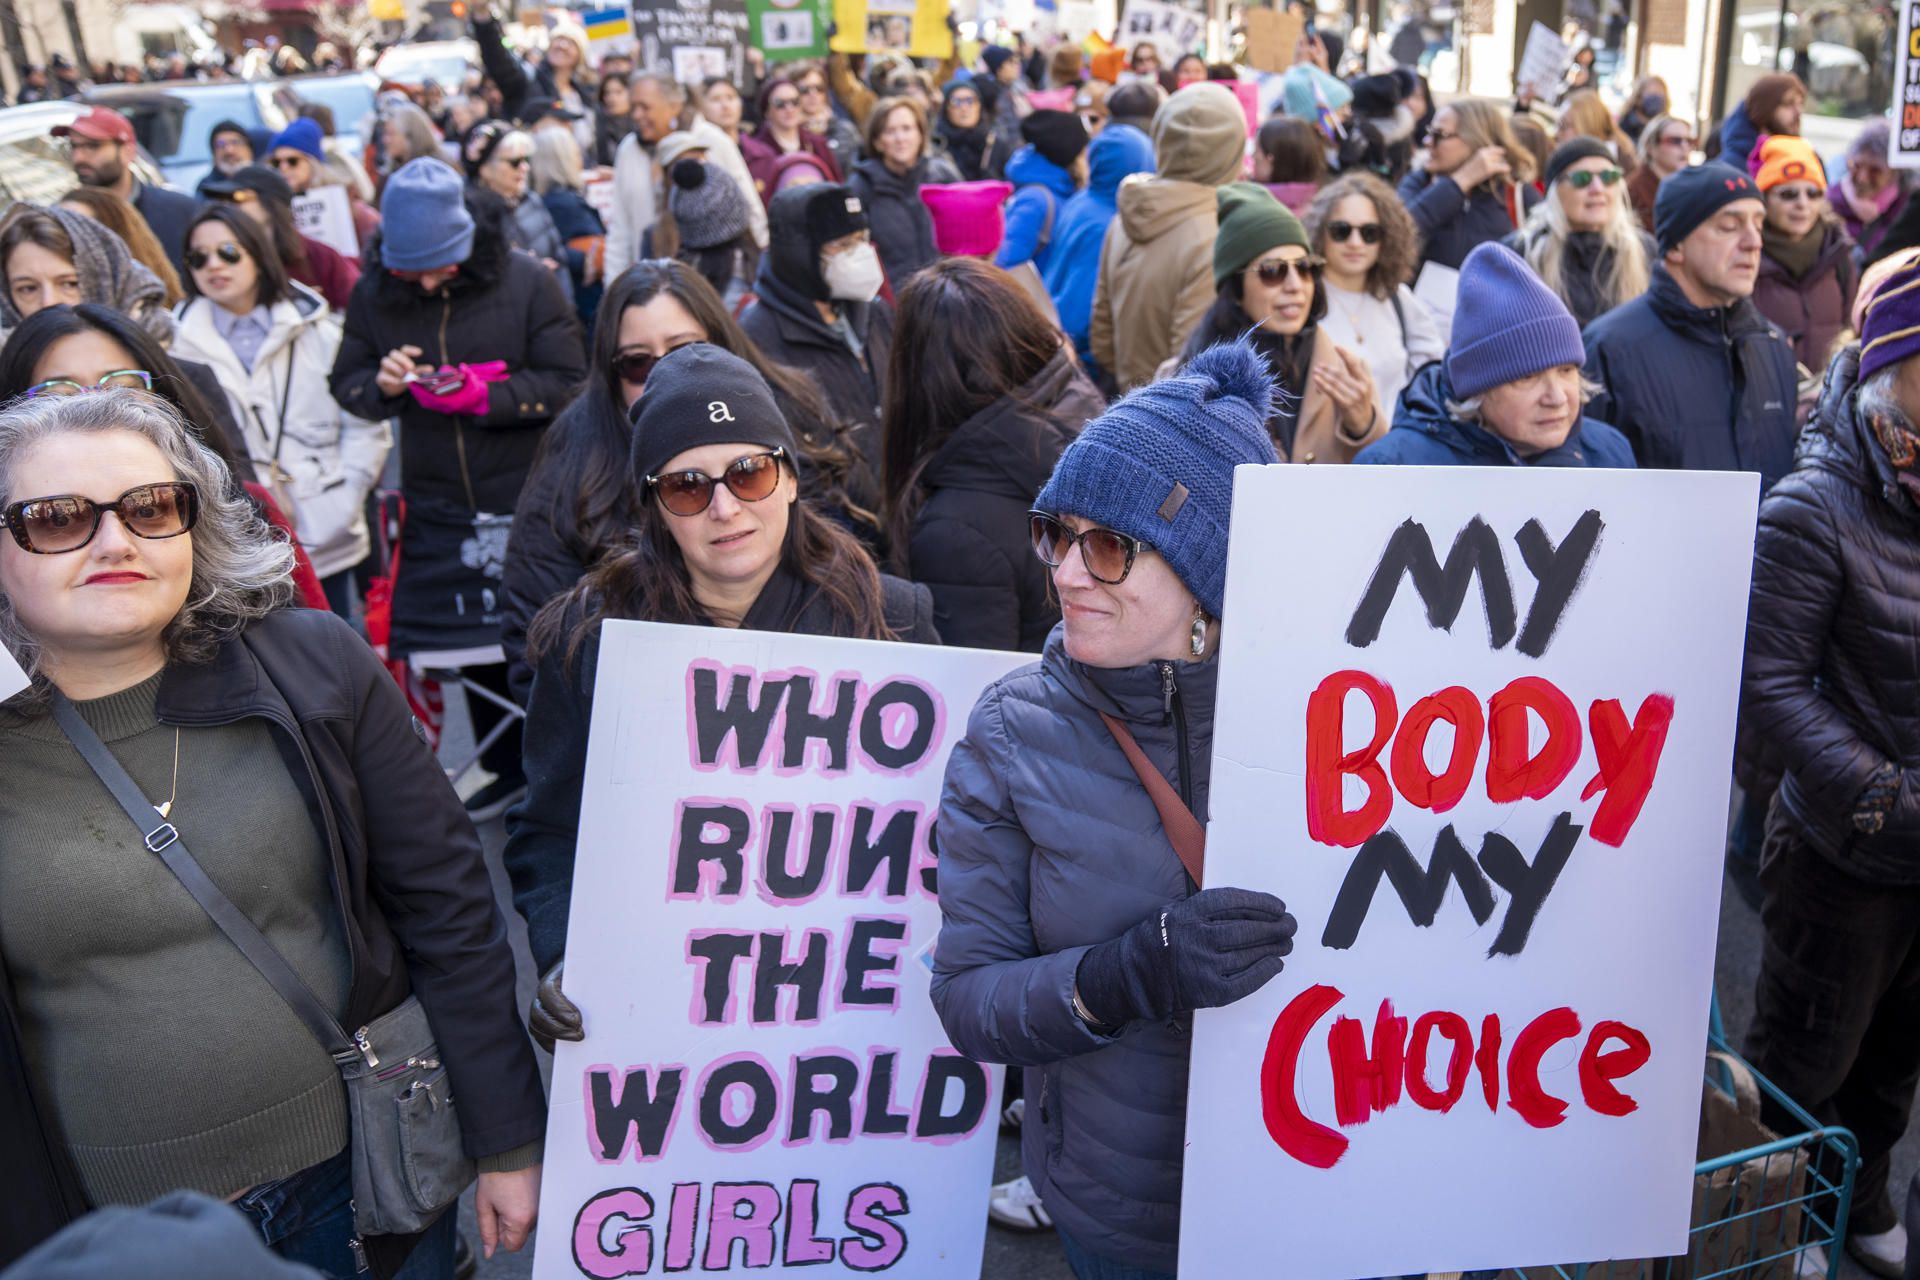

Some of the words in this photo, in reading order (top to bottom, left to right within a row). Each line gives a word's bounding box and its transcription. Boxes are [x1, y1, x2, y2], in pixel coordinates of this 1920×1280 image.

[707, 400, 736, 423] a
[1345, 508, 1606, 660] MY
[687, 658, 946, 777] WHO
[1306, 669, 1675, 848] BODY
[1321, 811, 1584, 960] MY
[685, 914, 911, 1028] THE
[584, 1045, 991, 1165] WORLD
[571, 1178, 910, 1280] GIRLS
